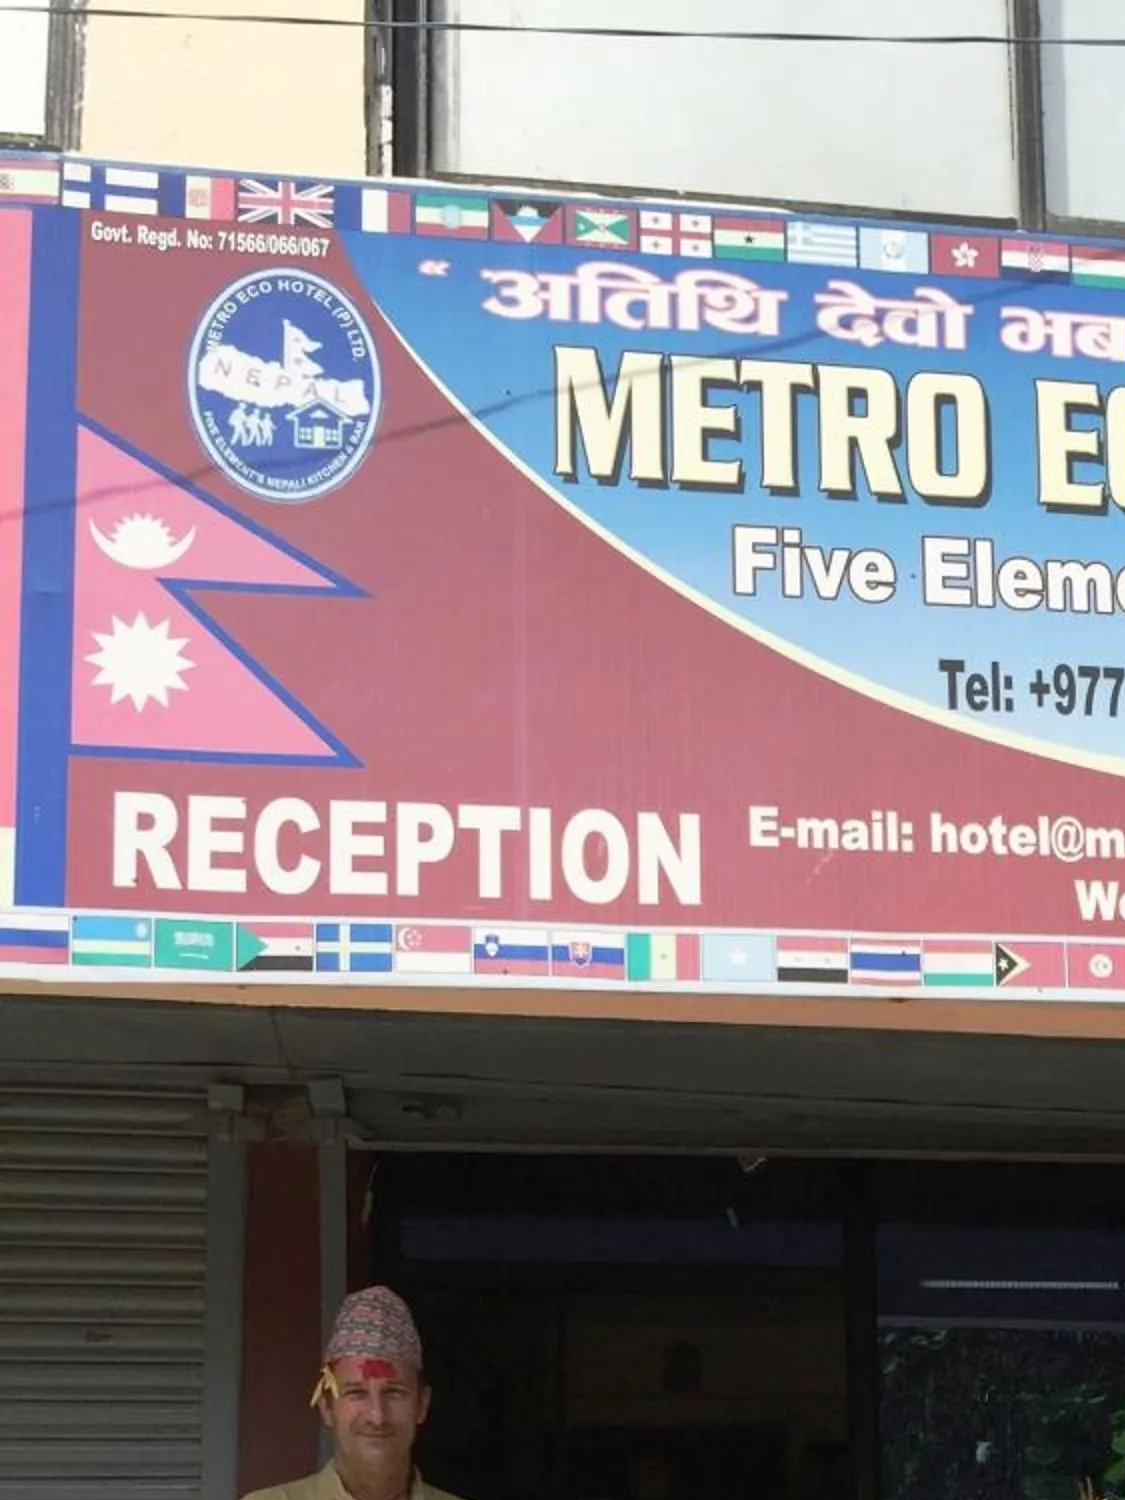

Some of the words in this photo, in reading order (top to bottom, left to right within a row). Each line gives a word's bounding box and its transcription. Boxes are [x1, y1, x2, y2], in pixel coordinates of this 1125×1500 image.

[91, 221, 132, 243] Govt.
[137, 225, 181, 251] Regd.
[187, 229, 213, 249] No:
[218, 231, 330, 257] 71566/066/067
[206, 300, 237, 351] METRO
[236, 281, 272, 304] ECO
[278, 280, 333, 310] HOTEL
[331, 306, 354, 329] (P)
[480, 260, 789, 337] अतिथि
[214, 358, 346, 405] NEPAL
[553, 345, 993, 508] METRO
[732, 525, 897, 602] Five
[939, 659, 1013, 713] Tel:
[112, 791, 702, 906] RECEPTION
[748, 806, 914, 853] E-mail:
